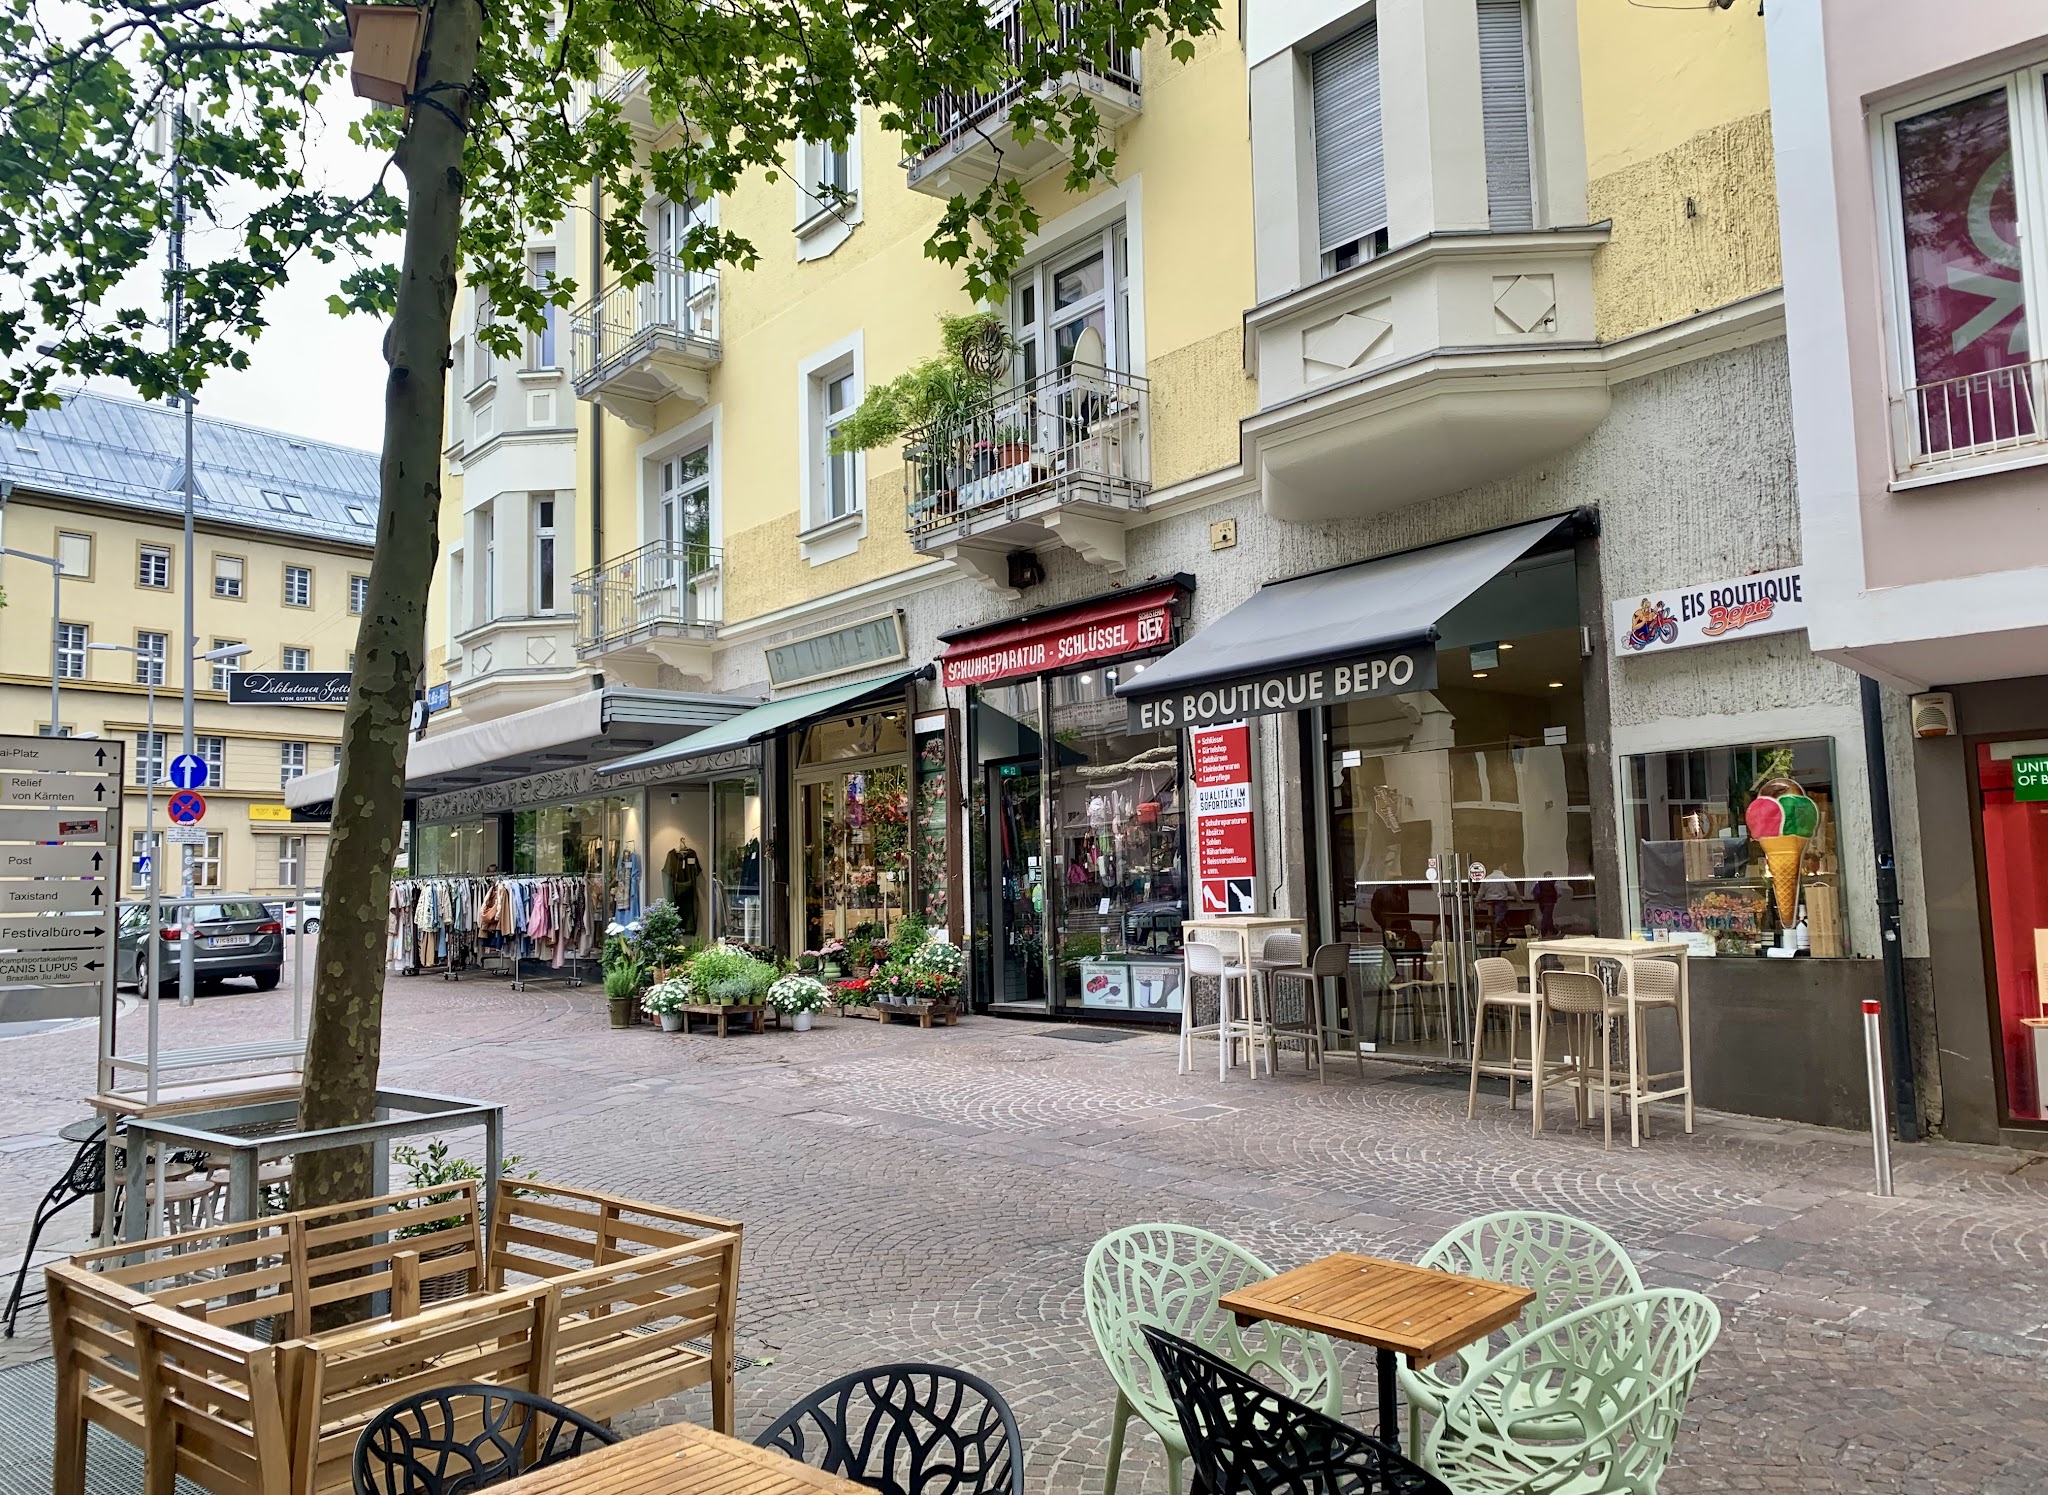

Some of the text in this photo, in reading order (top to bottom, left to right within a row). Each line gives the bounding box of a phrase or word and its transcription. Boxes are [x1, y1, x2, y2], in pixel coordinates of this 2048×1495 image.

[1681, 575, 1802, 622] EIS BOUTIQUE
[1702, 597, 1775, 636] Bepo
[774, 621, 892, 678] BLUMEN
[948, 643, 1045, 681] SCHUHREPARATUR
[1058, 624, 1128, 659] SCHLÜSSEL
[1138, 617, 1163, 643] DER
[243, 674, 319, 694] Delikatessen
[1140, 654, 1414, 729] EIS BOUTIQUE BEPO
[1201, 735, 1224, 745] Schlüssel
[1203, 763, 1240, 773] Kleinlederwaren
[12, 778, 42, 787] Relief
[1203, 773, 1230, 783] Lederpflege
[2018, 775, 2037, 786] OF
[34, 792, 75, 801] Kärnten
[1200, 787, 1245, 801] QUALITÄT IM
[1200, 798, 1246, 811] SOFORTDIENST
[1205, 818, 1247, 827] Schuhreparaturen
[8, 856, 32, 865] Post
[9, 892, 58, 901] Taxistand
[2, 927, 81, 938] Festivalbüro
[0, 955, 78, 965] Kampfsportakademie
[0, 962, 78, 975] CANIS LUPUS
